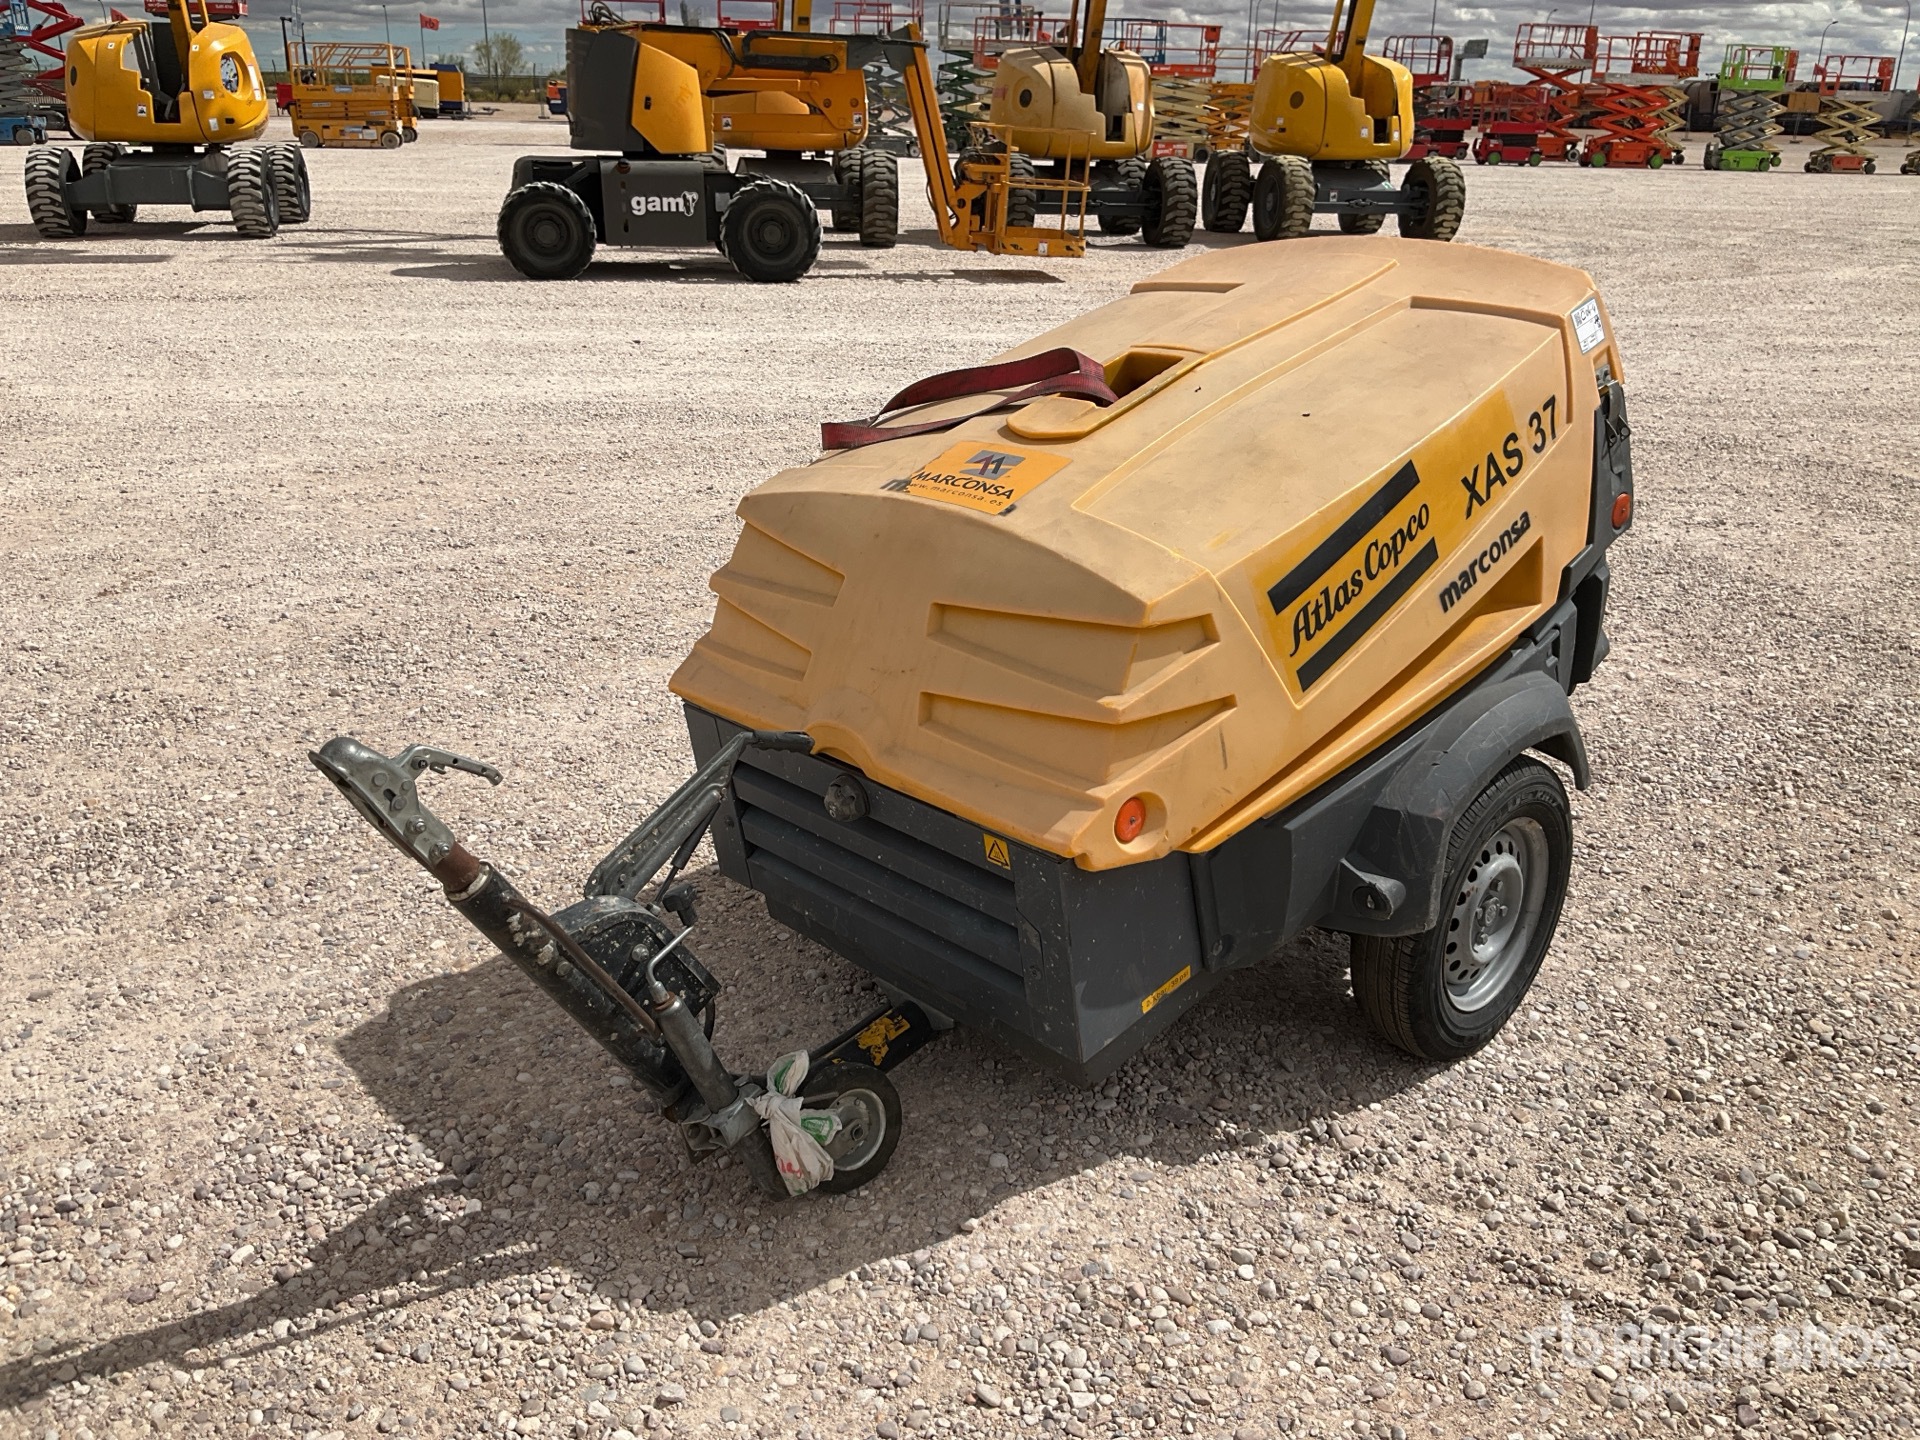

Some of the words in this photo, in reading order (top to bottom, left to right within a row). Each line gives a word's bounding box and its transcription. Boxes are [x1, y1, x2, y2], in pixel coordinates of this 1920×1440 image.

[630, 196, 685, 216] gam
[911, 471, 1015, 500] MARCONSA
[1461, 432, 1524, 520] XAS
[1528, 394, 1557, 454] 37
[1289, 569, 1364, 658] Atlas
[1364, 503, 1430, 581] Copco
[1439, 511, 1532, 614] marconsa
